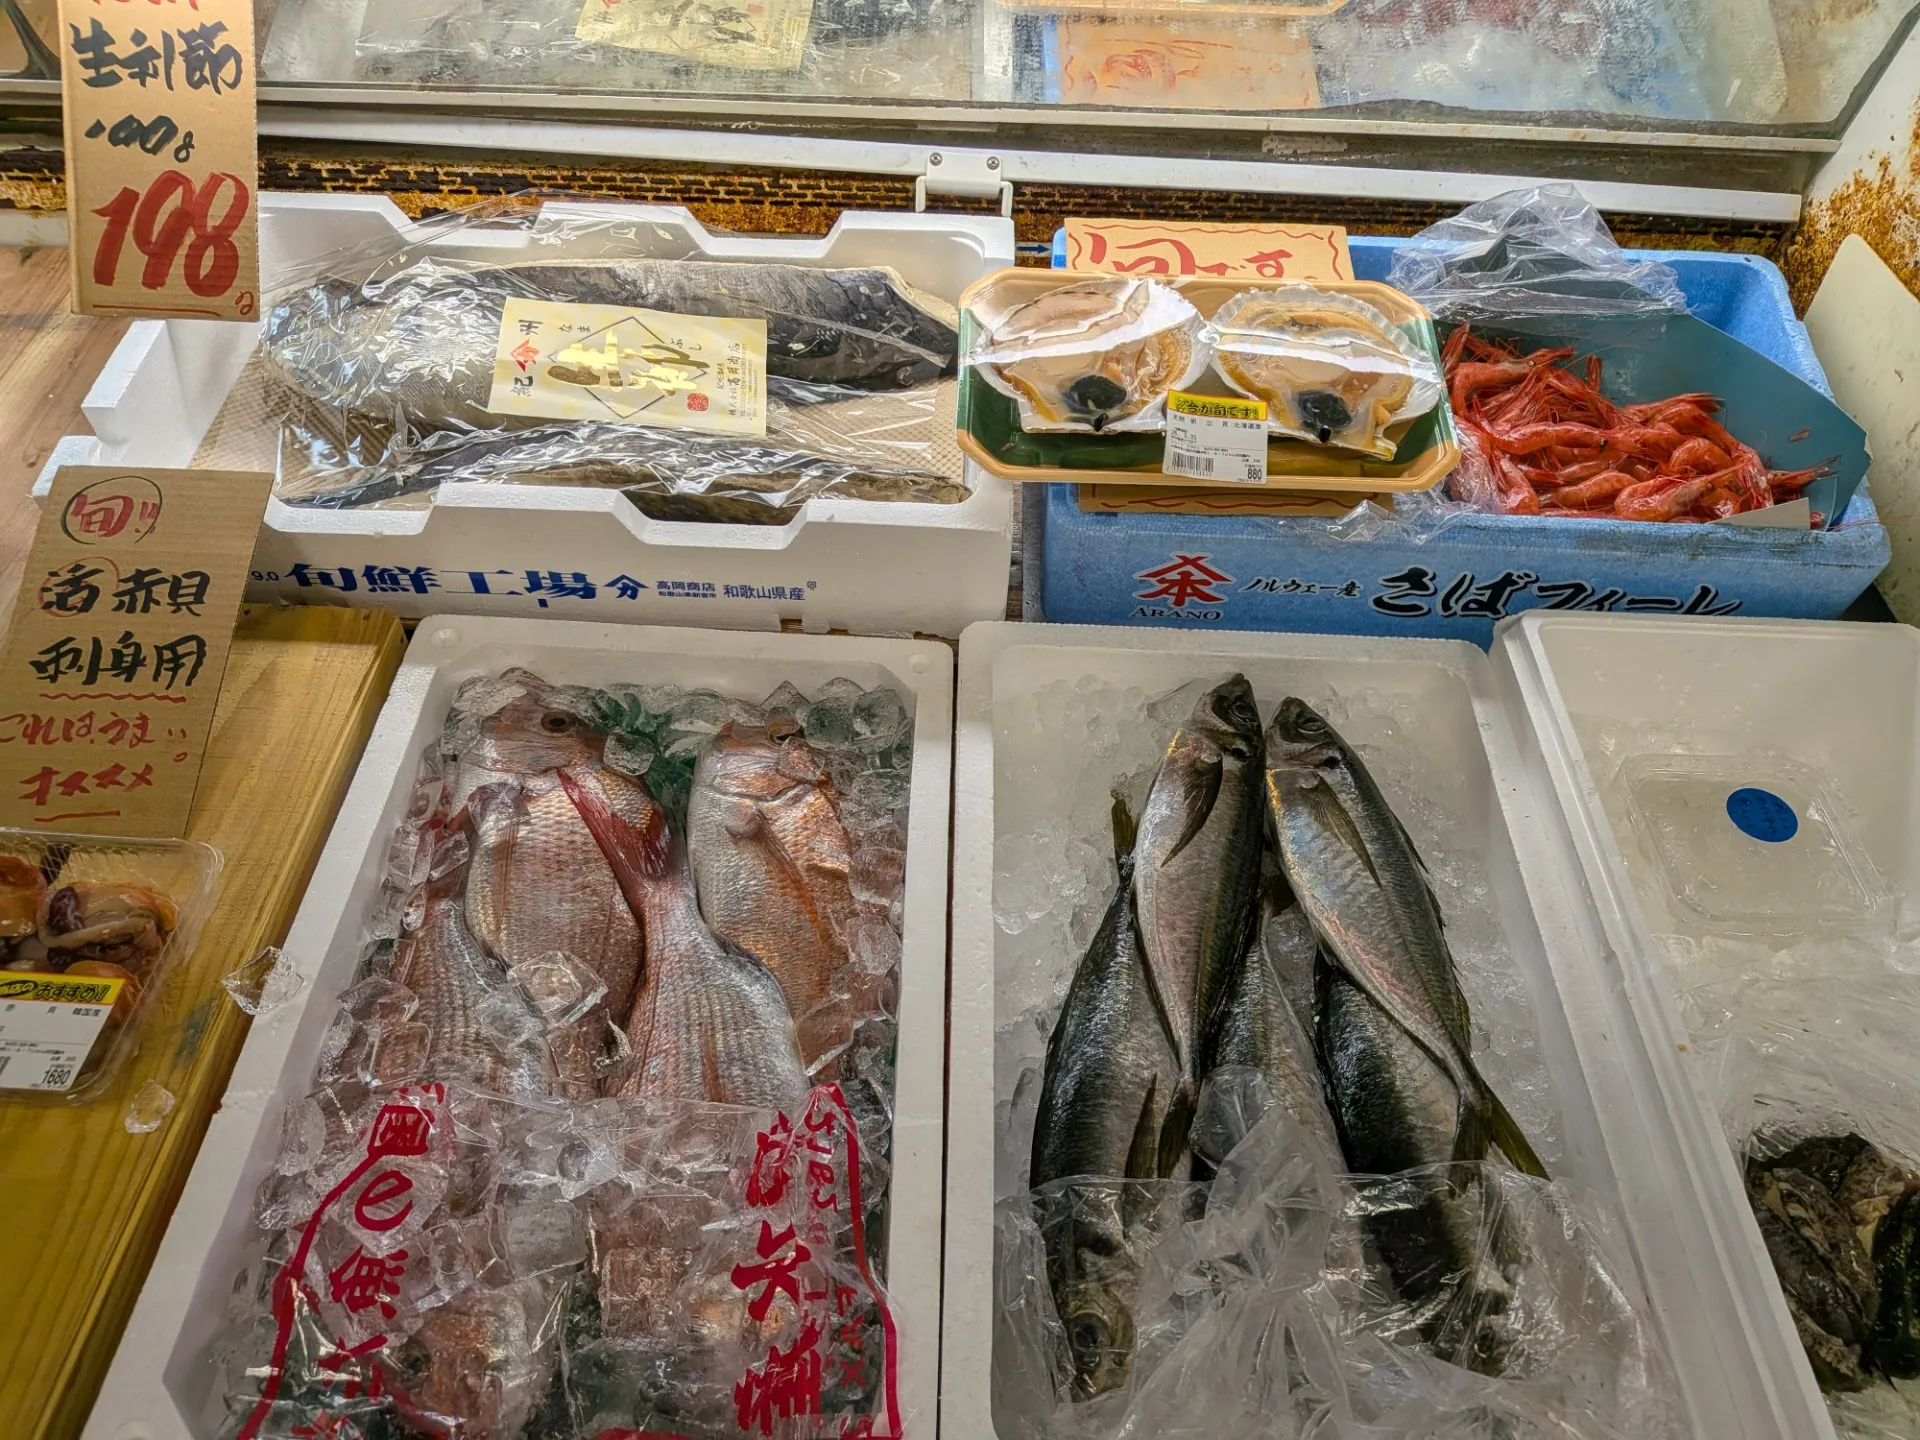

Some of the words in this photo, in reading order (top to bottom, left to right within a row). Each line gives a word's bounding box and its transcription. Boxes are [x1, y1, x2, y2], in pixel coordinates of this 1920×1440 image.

[91, 169, 250, 298] 198
[1247, 468, 1262, 480] 880
[251, 570, 280, 582] 9.0
[284, 562, 598, 601] 旬鮮工場
[656, 580, 716, 592] 高岡商店
[723, 583, 806, 601] 和歌山県産
[1241, 577, 1361, 598] ノルウェー産
[1130, 606, 1221, 621] ARANO
[28, 630, 208, 690] 刺身用
[18, 762, 154, 806] オススメ
[42, 1069, 72, 1085] 1680
